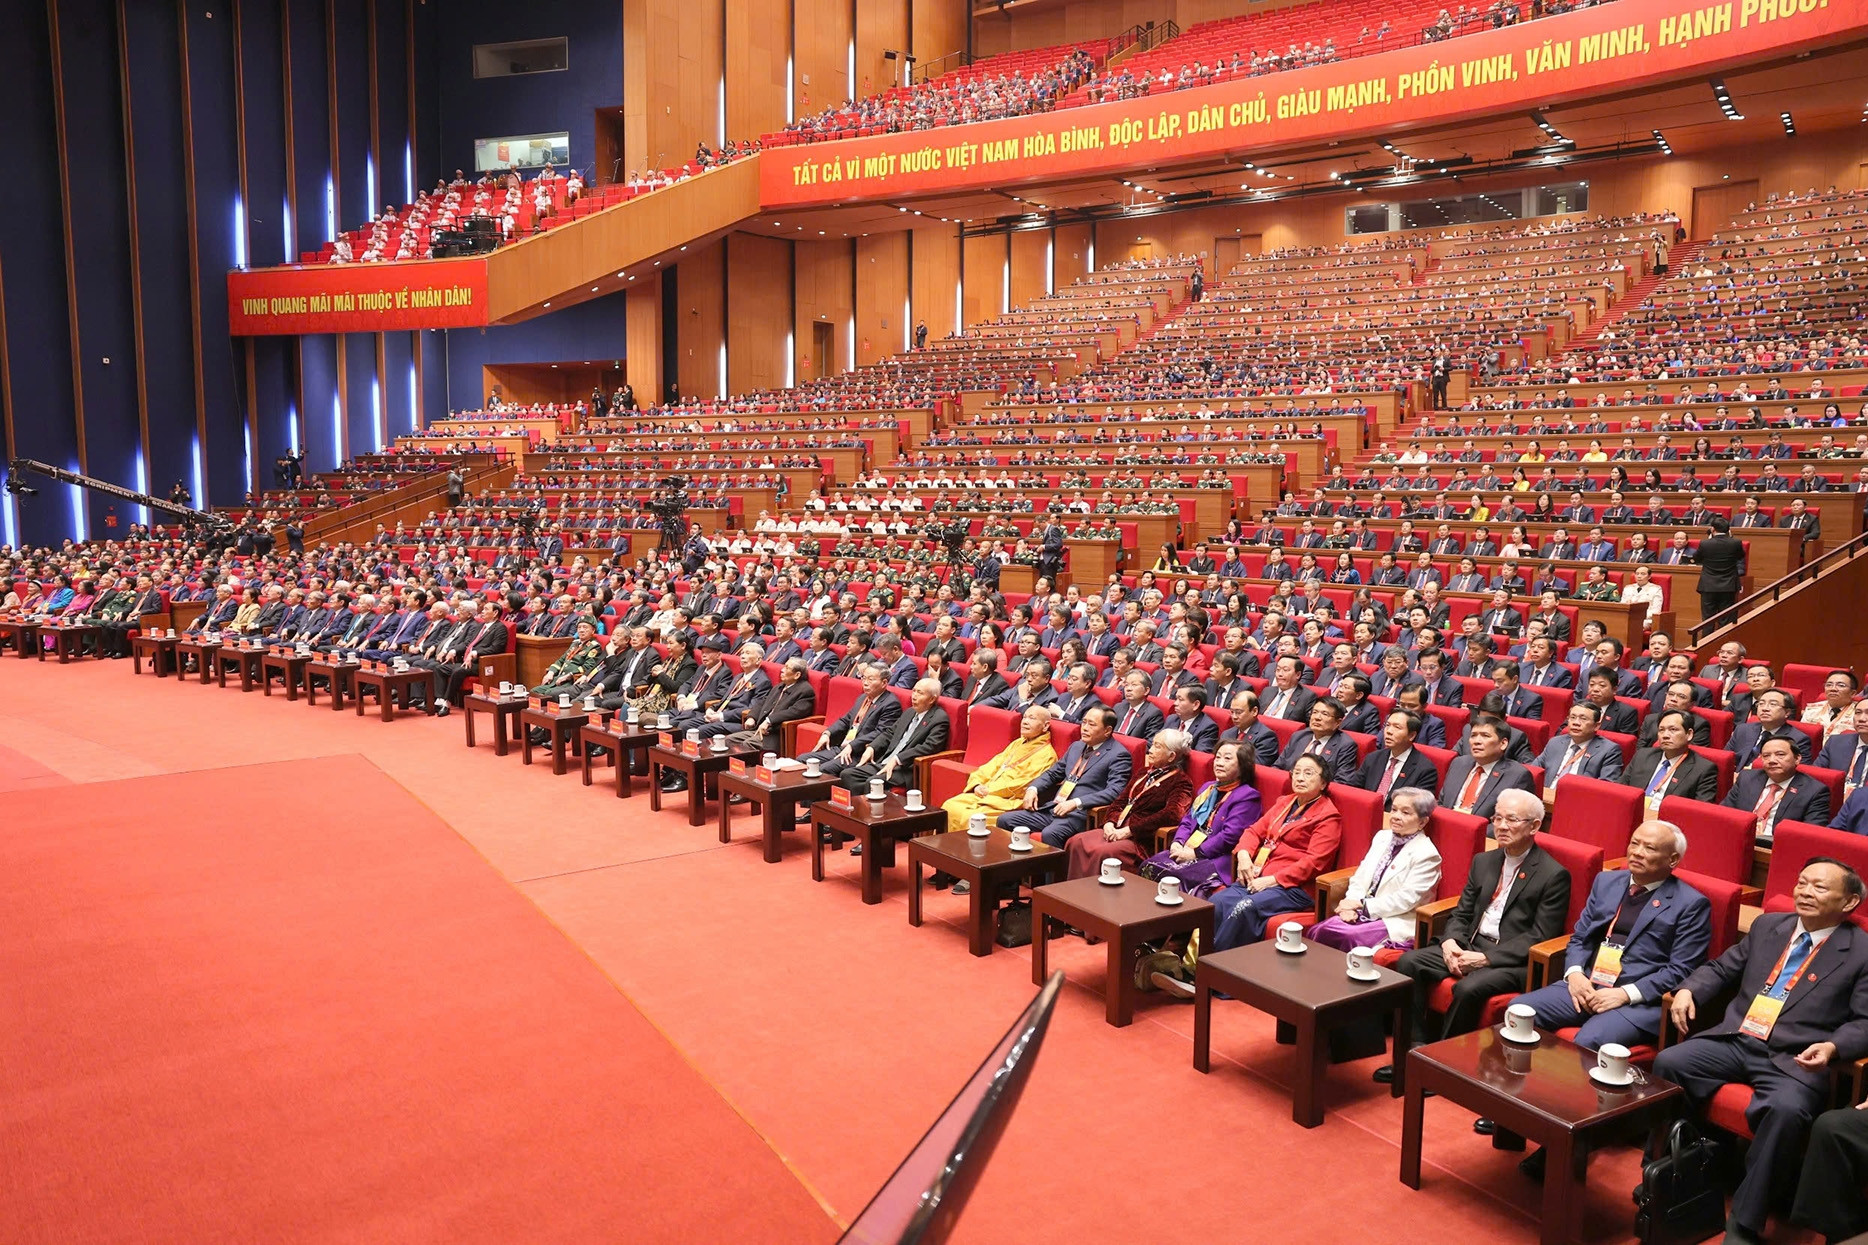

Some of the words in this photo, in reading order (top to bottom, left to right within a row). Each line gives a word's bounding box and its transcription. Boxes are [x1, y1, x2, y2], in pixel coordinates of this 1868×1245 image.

[792, 157, 819, 186] TẤT
[822, 155, 842, 183] CẢ
[846, 155, 860, 180] VÌ
[864, 151, 897, 181] MỘT
[900, 145, 942, 174] NƯỚC
[945, 141, 979, 171] VIỆT
[982, 138, 1019, 164] NAM
[1023, 130, 1056, 159] HÒA
[1060, 125, 1105, 153] BÌNH,
[1108, 117, 1144, 149] ĐỘC
[1147, 111, 1183, 144] LẬP,
[1187, 103, 1225, 134] DÂN
[1229, 91, 1271, 127] CHỦ,
[1276, 87, 1322, 120] GIÀU
[1326, 77, 1392, 114] MẠNH,
[1397, 59, 1455, 100] PHỒN
[1461, 53, 1518, 88] VINH,
[1525, 38, 1572, 75] VĂN
[1578, 23, 1651, 65] MINH,
[1658, 2, 1733, 49] HẠNH
[243, 298, 268, 315] VINH
[271, 296, 307, 316] QUANG
[310, 292, 331, 313] MÃI
[333, 291, 355, 312] MÃI
[357, 289, 393, 314] THUỘC
[394, 286, 409, 309] VỀ
[411, 286, 442, 308] NHÂN
[444, 284, 472, 306] DÂN!
[84, 480, 135, 499] EGRIPMENT
[151, 500, 188, 515] SCANNER
